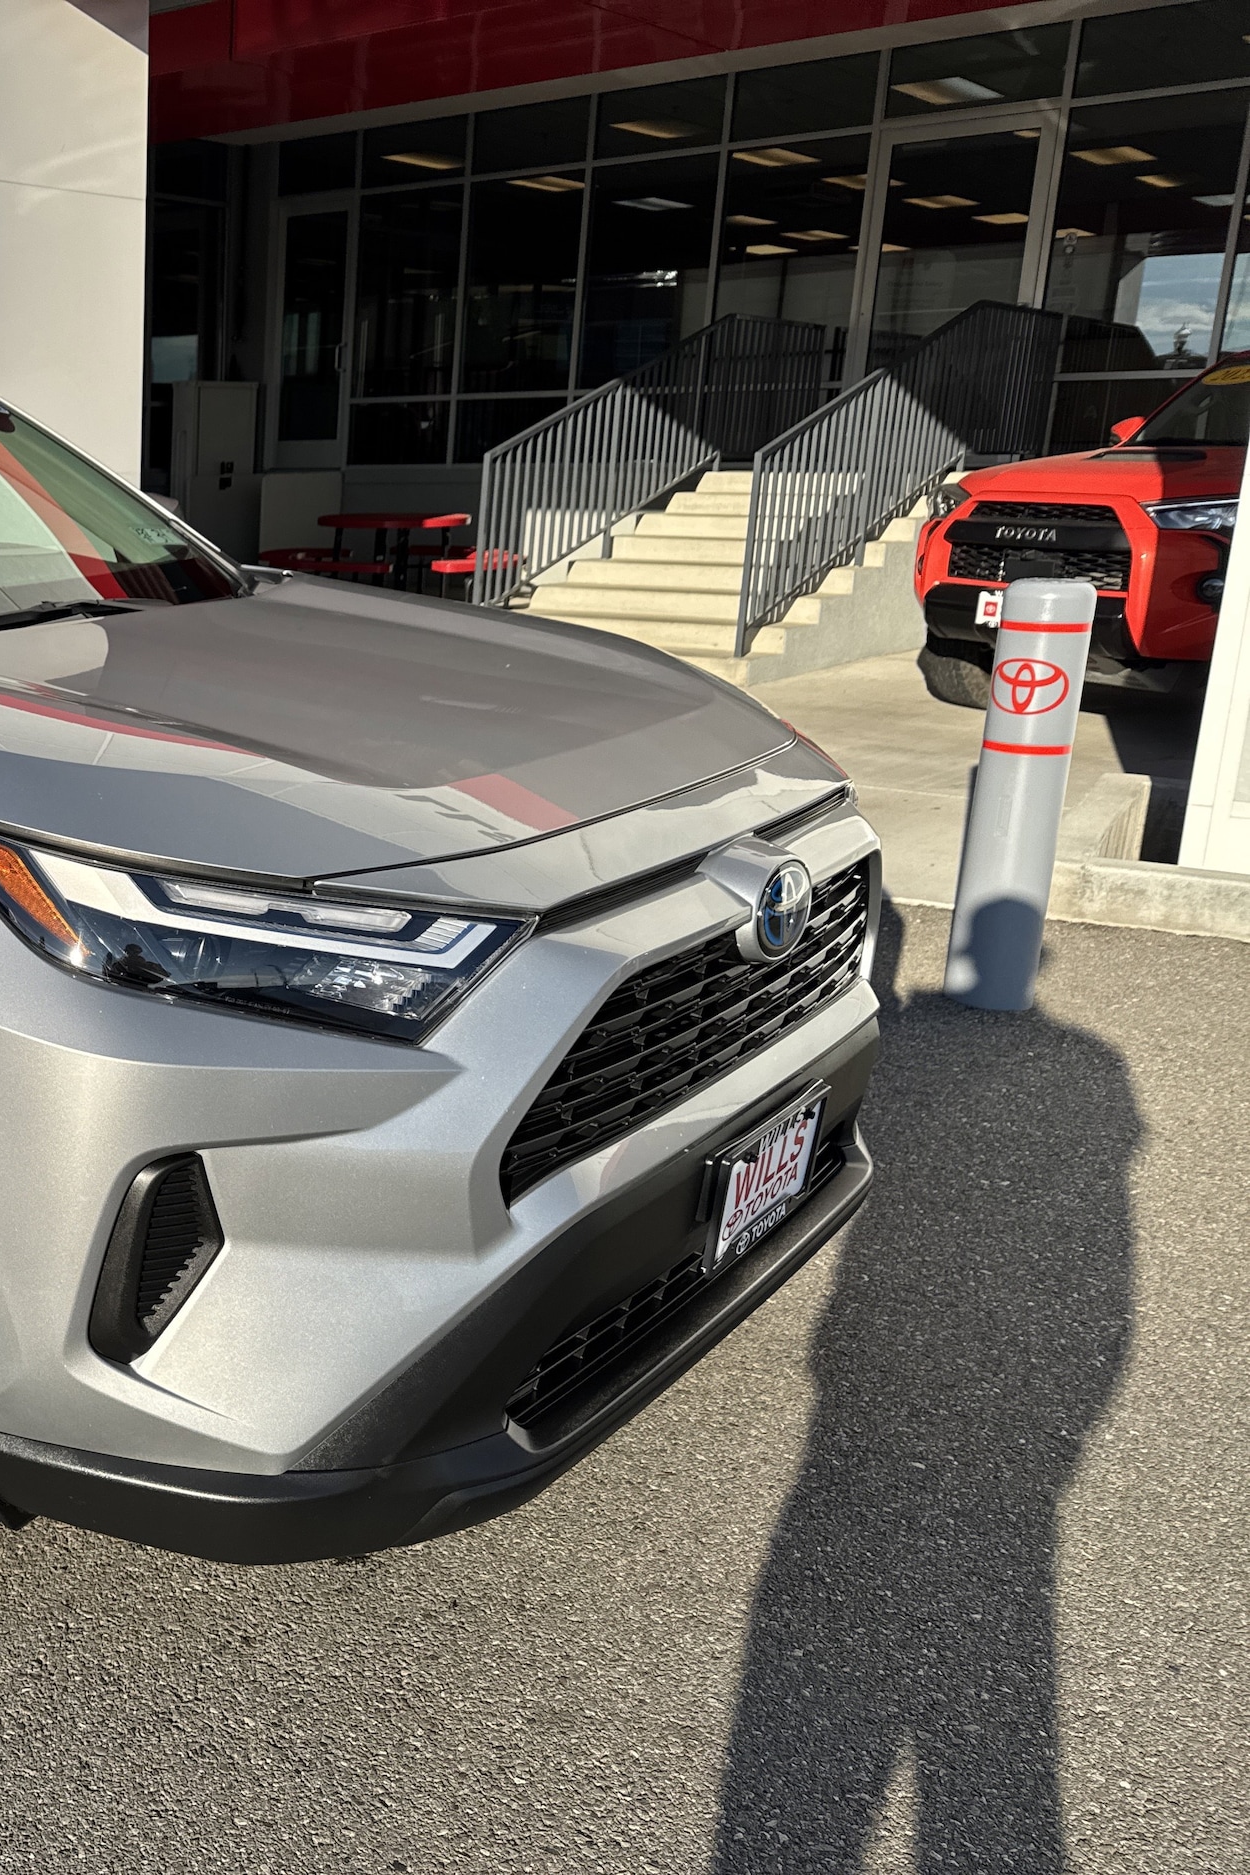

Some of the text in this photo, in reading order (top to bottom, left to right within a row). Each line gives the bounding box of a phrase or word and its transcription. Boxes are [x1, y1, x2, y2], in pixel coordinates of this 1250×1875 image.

[995, 525, 1057, 542] TOYOTA
[734, 1119, 808, 1210] WILLS
[743, 1161, 798, 1224] TOYOTA
[751, 1202, 786, 1243] TOYOTA
